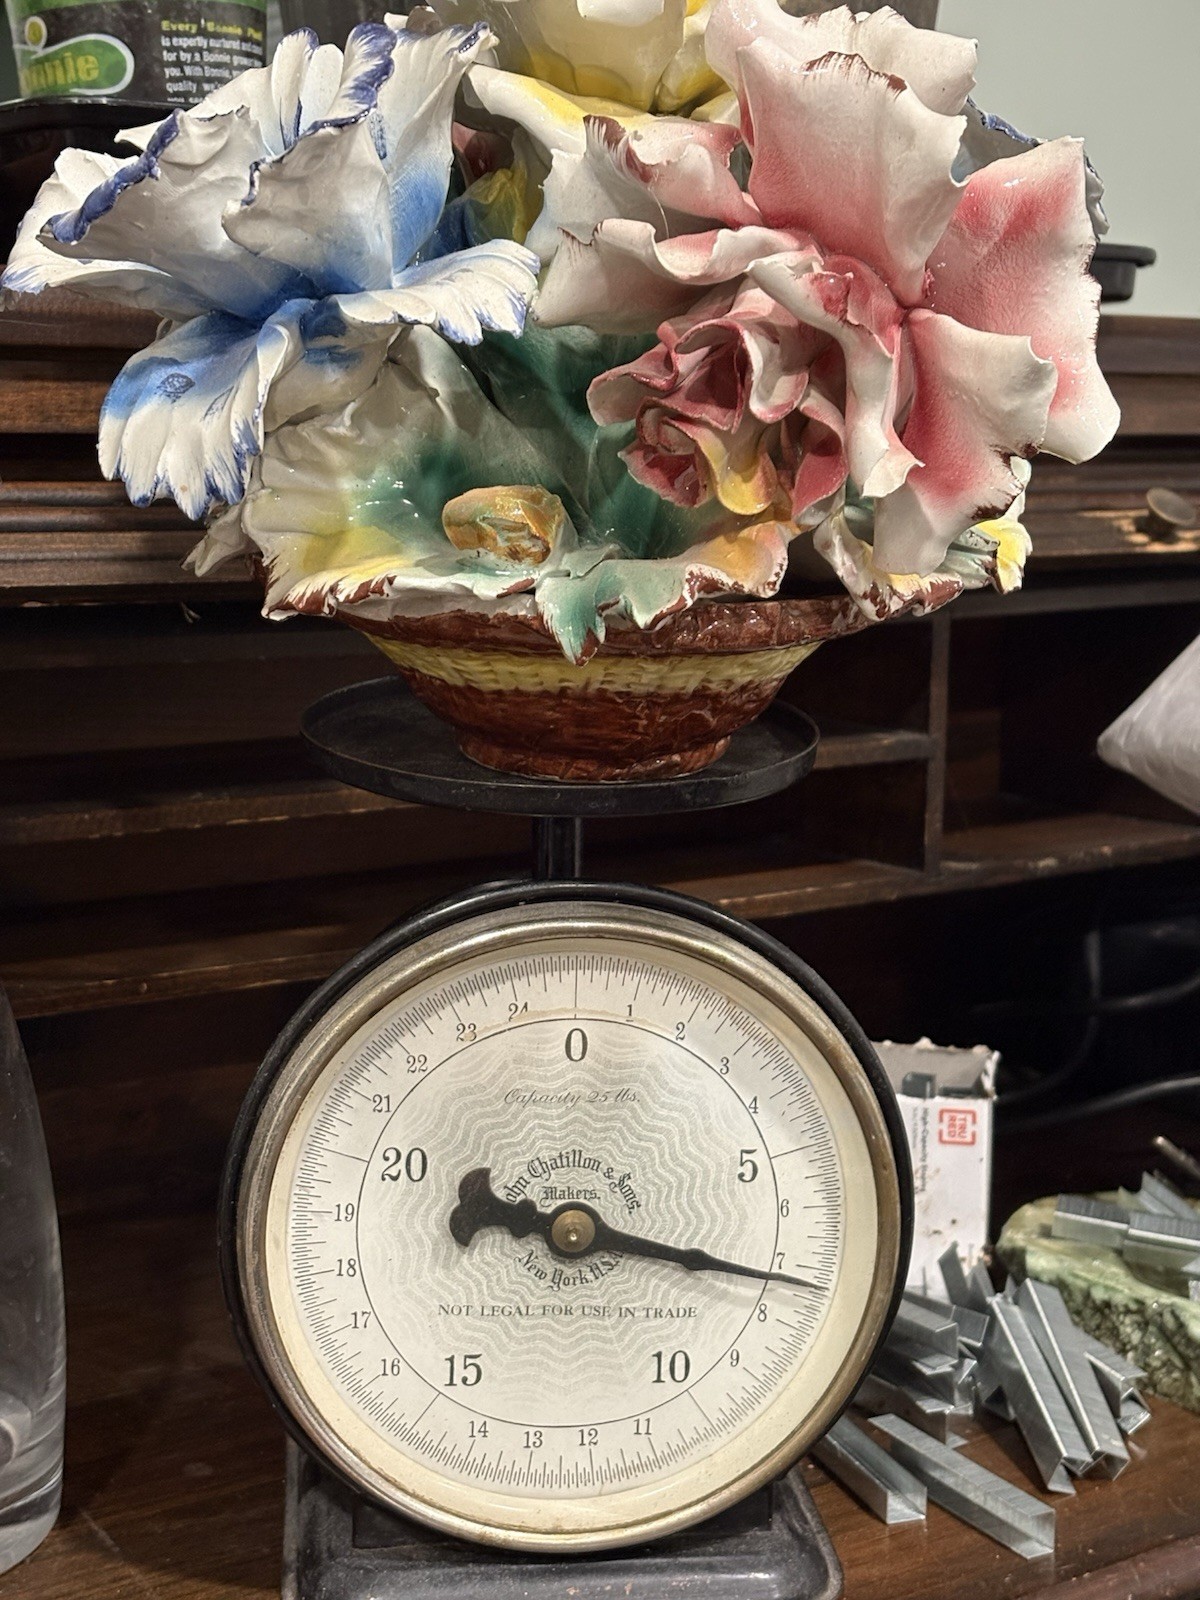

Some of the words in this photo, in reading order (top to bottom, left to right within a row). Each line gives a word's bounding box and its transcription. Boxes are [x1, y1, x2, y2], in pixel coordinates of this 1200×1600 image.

[161, 20, 198, 33] Every
[161, 35, 171, 46] is
[172, 36, 208, 49] expertly
[163, 50, 177, 61] for
[179, 50, 192, 63] by
[194, 52, 200, 61] a
[202, 51, 231, 63] Bonnie
[164, 67, 183, 79] you.
[183, 65, 203, 76] With
[204, 66, 232, 79] Bonnie,
[166, 80, 197, 93] quality
[626, 1004, 634, 1022] 1
[456, 1023, 477, 1042] 23
[675, 1021, 686, 1041] 2
[565, 1028, 588, 1062] 0
[406, 1054, 428, 1073] 22
[719, 1057, 730, 1075] 3
[372, 1094, 392, 1113] 21
[504, 1088, 582, 1109] Capacity
[587, 1090, 609, 1103] 25
[749, 1096, 759, 1114] 4
[381, 1147, 428, 1182] 20
[737, 1149, 758, 1182] 5
[504, 1175, 530, 1203] ohn
[527, 1149, 602, 1181] Chatillon
[603, 1167, 614, 1179] &
[540, 1186, 601, 1207] Makers.
[334, 1203, 355, 1222] 19
[780, 1199, 789, 1217] 6
[336, 1258, 357, 1277] 18
[514, 1249, 547, 1280] New
[776, 1252, 786, 1270] 7
[351, 1311, 371, 1329] 17
[438, 1305, 472, 1316] NOT
[480, 1305, 535, 1317] LEGAL
[542, 1305, 574, 1316] FOR
[581, 1305, 610, 1317] USE
[618, 1307, 636, 1318] IN
[641, 1307, 698, 1318] TRADE
[757, 1303, 767, 1322] 8
[380, 1358, 401, 1376] 16
[651, 1350, 691, 1383] 10
[730, 1349, 740, 1367] 9
[443, 1353, 483, 1386] 15
[468, 1420, 489, 1438] 14
[633, 1418, 652, 1435] 11
[523, 1430, 543, 1448] 13
[578, 1428, 599, 1446] 12
